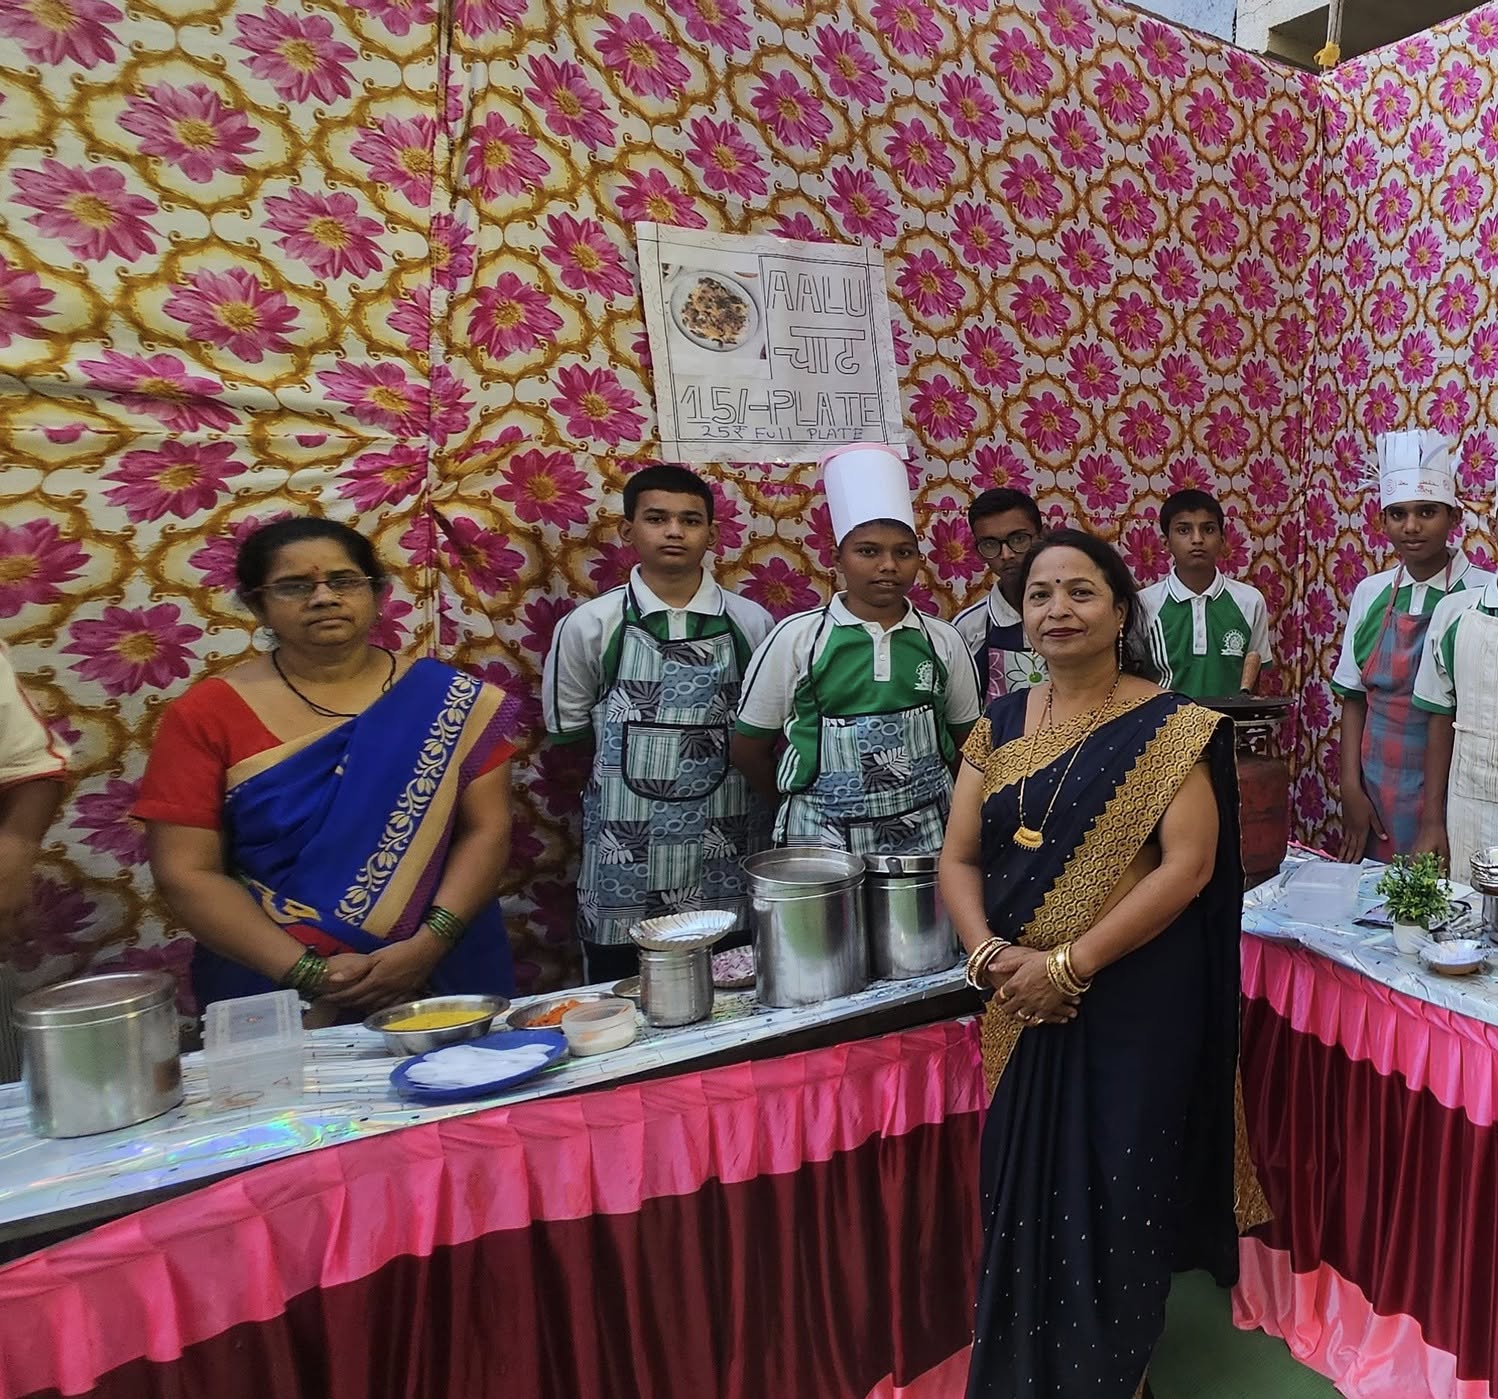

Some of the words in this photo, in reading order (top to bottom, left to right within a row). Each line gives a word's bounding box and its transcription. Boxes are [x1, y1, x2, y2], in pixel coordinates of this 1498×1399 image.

[766, 270, 867, 317] AALU
[774, 326, 865, 374] चाट
[756, 427, 792, 440] Full
[807, 428, 864, 440] PLATE
